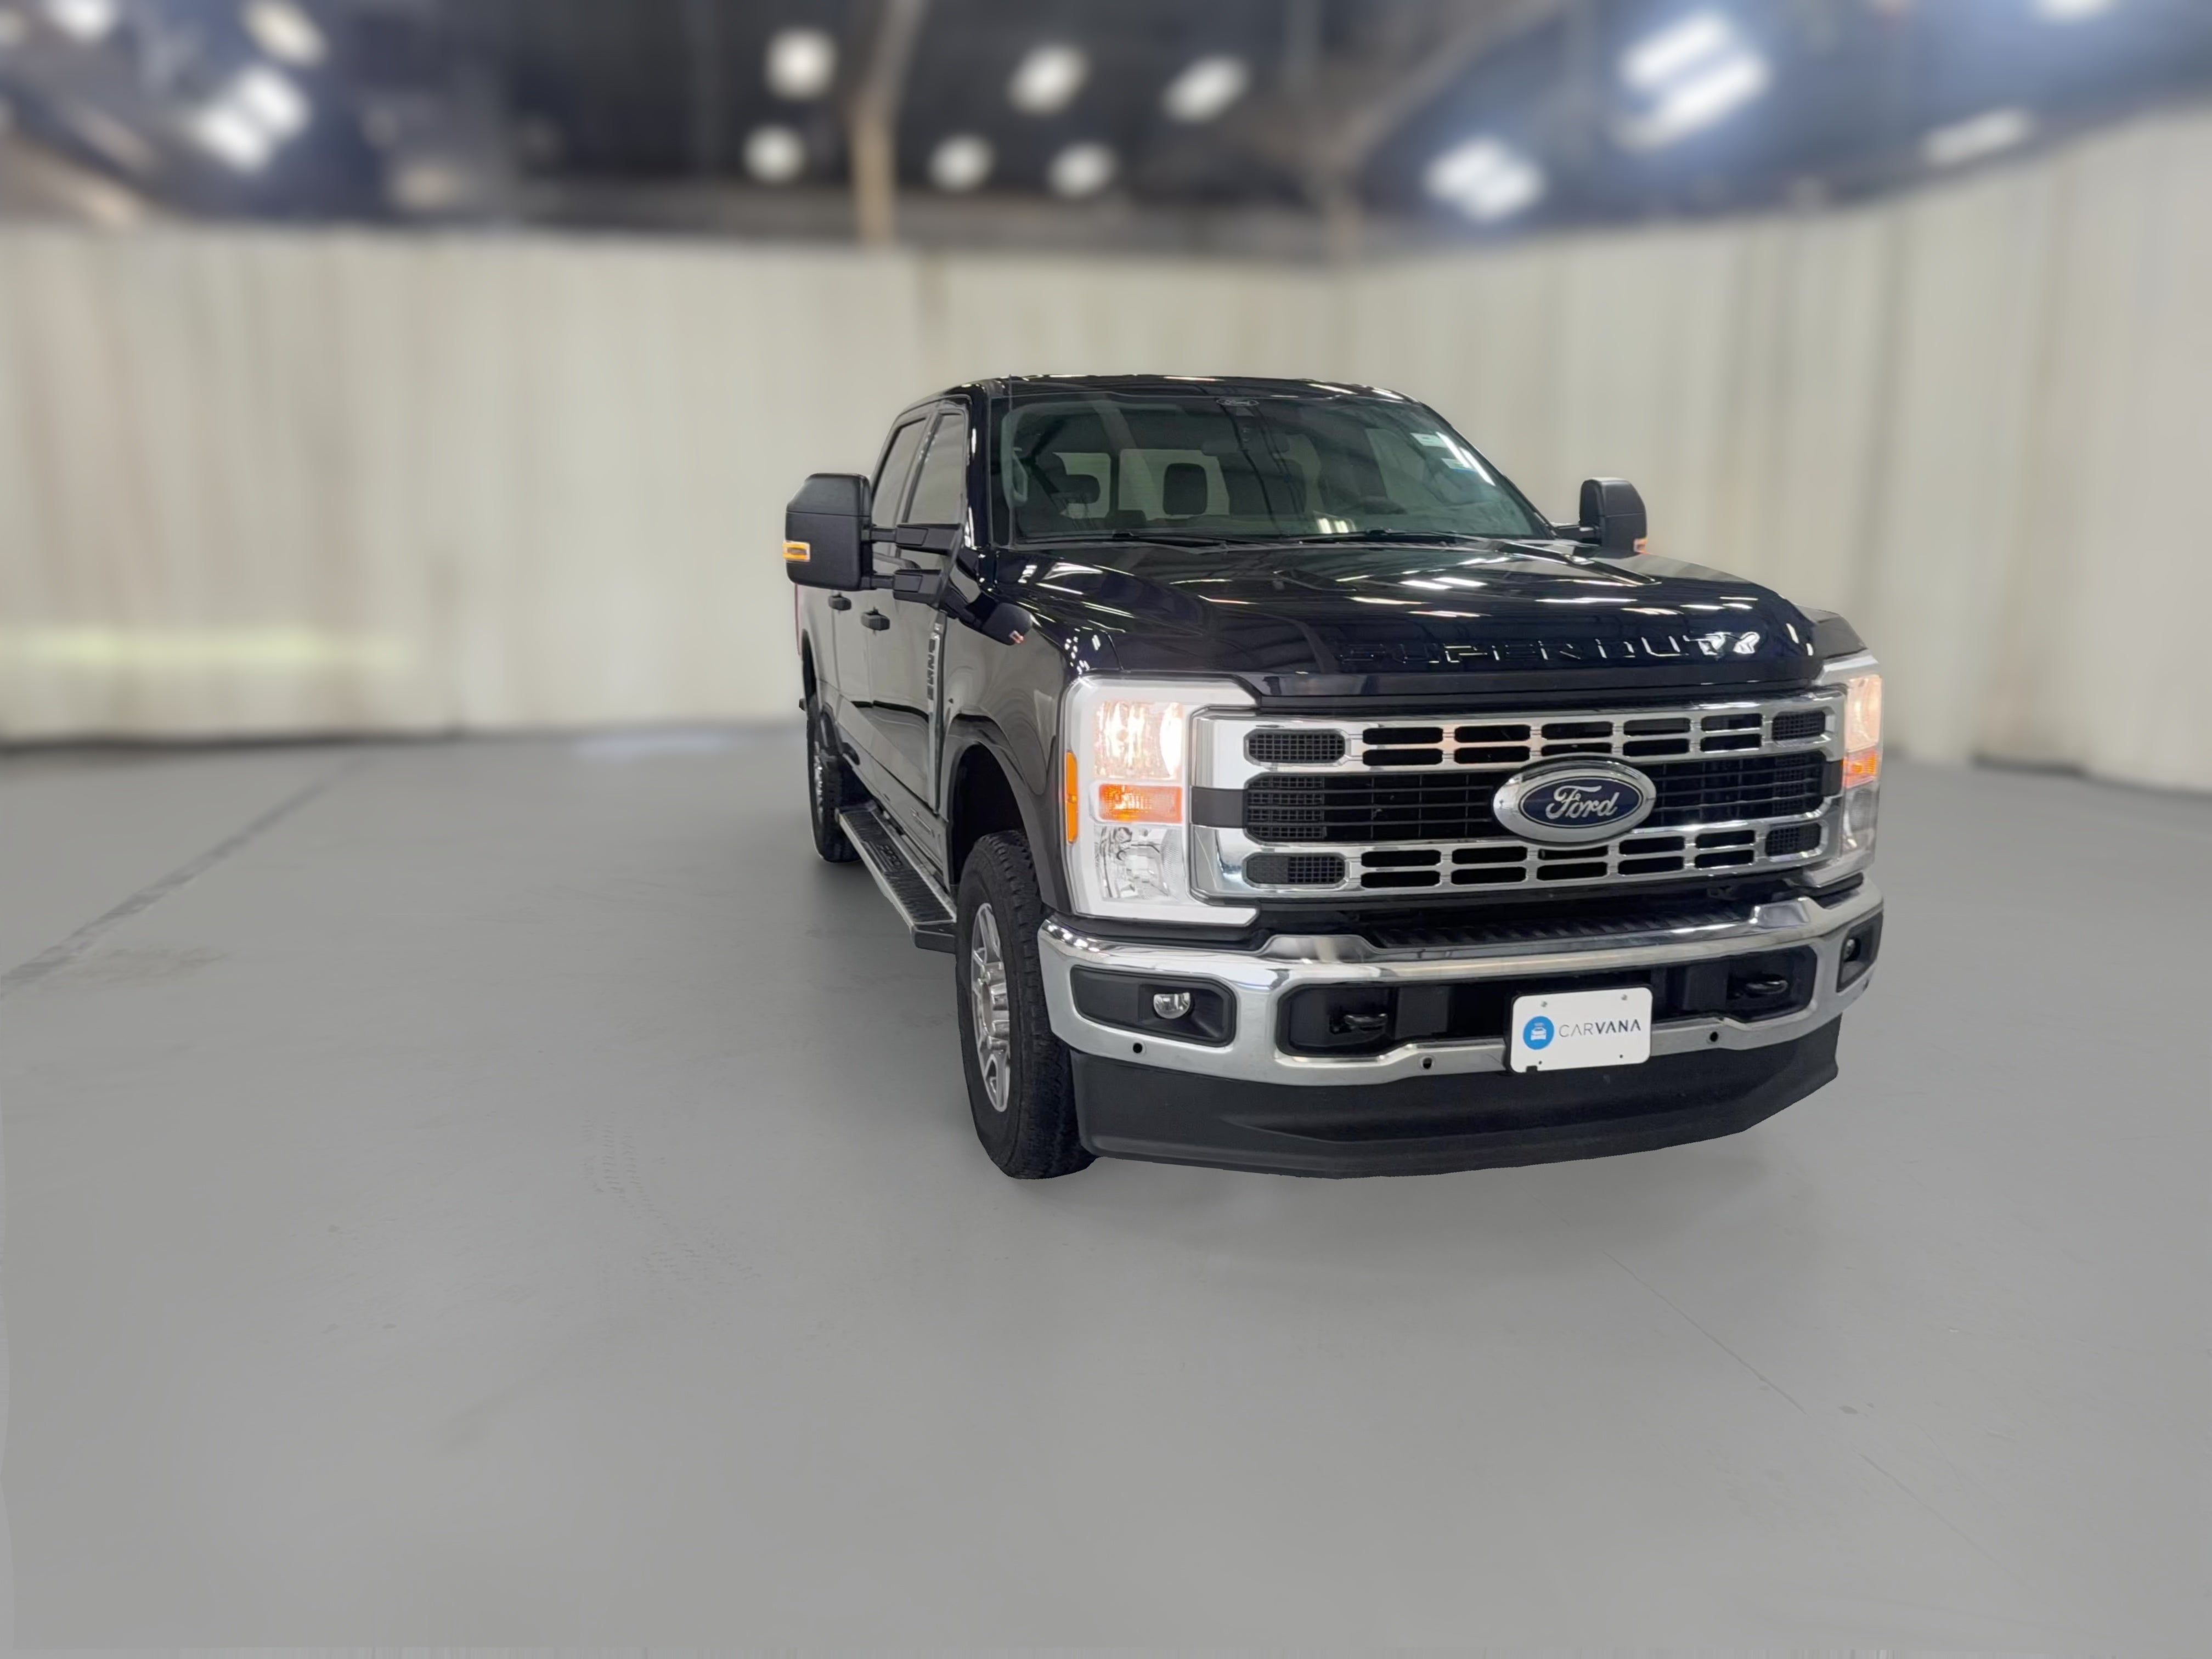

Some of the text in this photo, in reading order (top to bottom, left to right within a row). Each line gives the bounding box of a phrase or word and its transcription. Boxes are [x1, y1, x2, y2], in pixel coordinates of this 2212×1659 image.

[1594, 631, 1760, 660] DUTY
[1545, 785, 1620, 819] Ford
[1558, 1019, 1641, 1037] CARVANA
